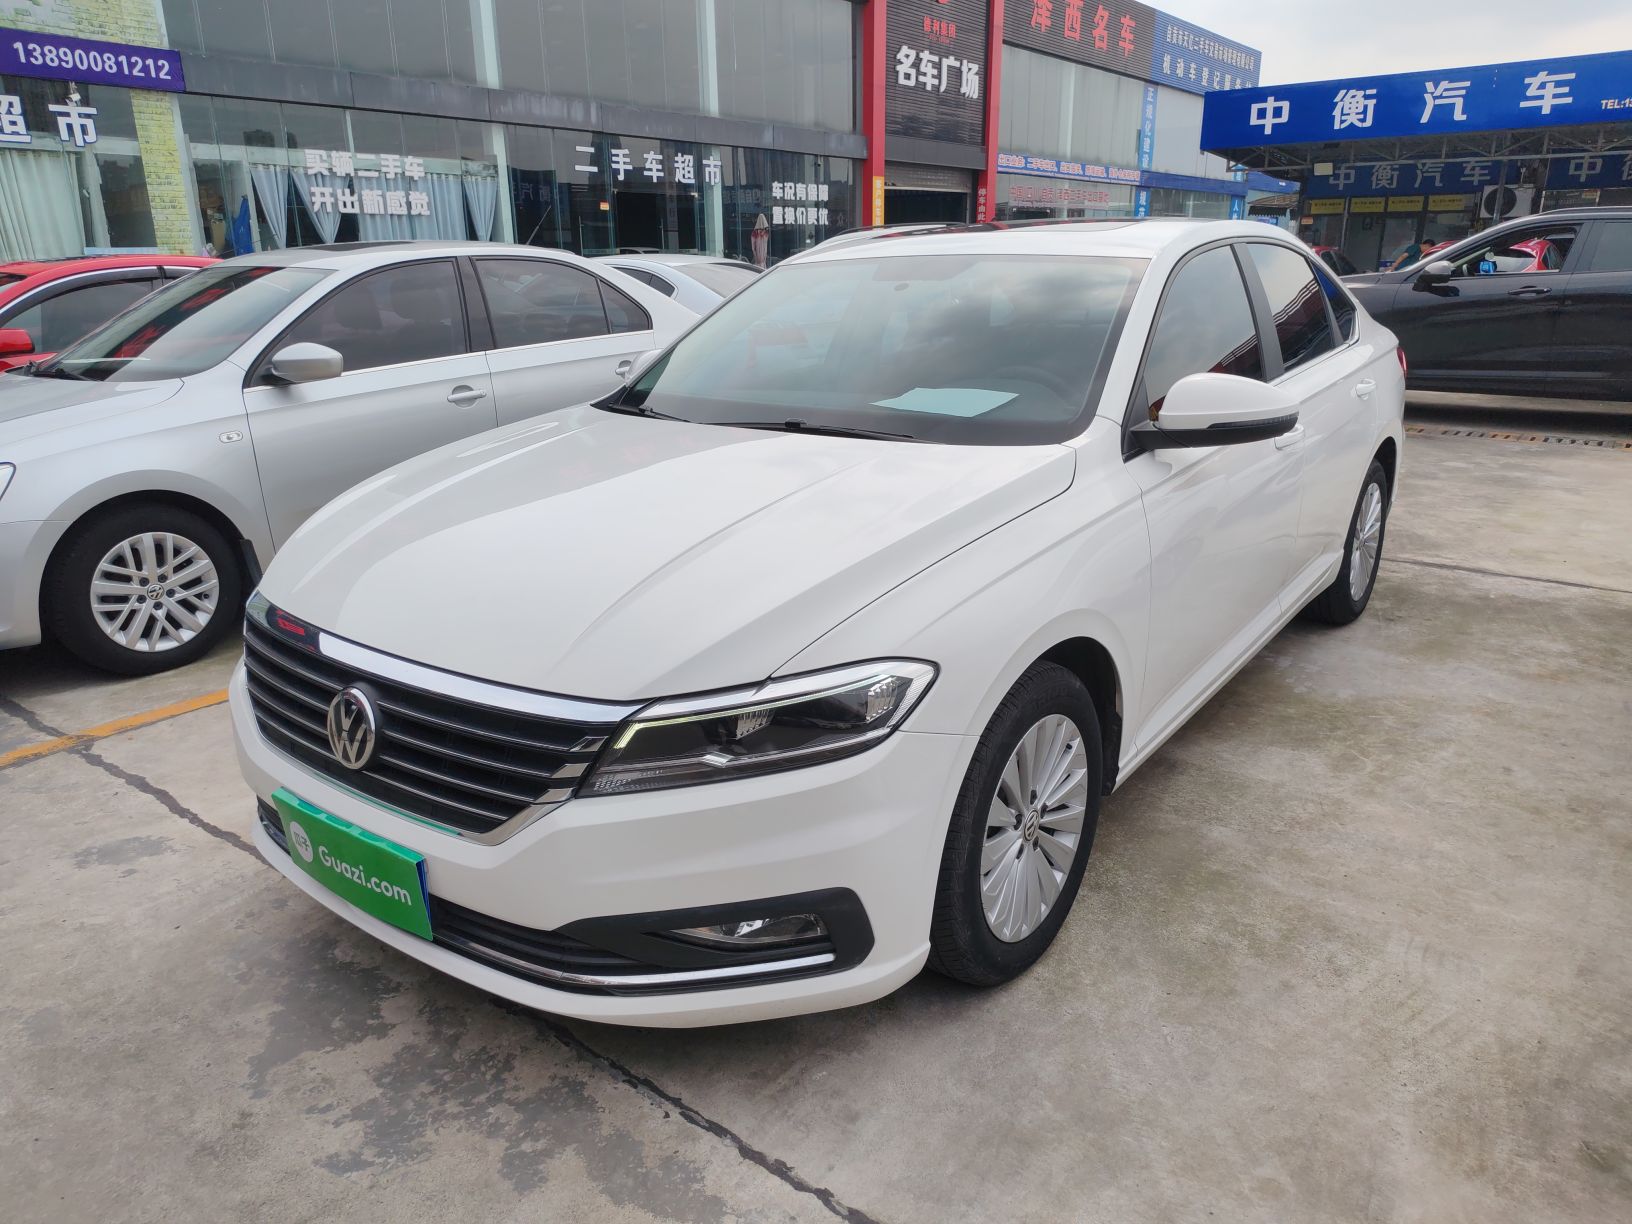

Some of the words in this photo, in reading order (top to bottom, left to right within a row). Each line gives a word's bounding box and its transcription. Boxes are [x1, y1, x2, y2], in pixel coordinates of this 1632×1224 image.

[13, 41, 171, 80] 13890081212
[895, 45, 979, 99] 名车广场
[1249, 71, 1576, 136] 中衡汽车
[304, 149, 426, 180] 买辆二手车
[574, 145, 722, 187] 二手车超市
[1328, 160, 1494, 191] 中衡汽车
[310, 186, 431, 216] 开出新感觉
[771, 181, 829, 202] 车况有保障
[771, 206, 829, 225] 置换价更优
[318, 845, 412, 906] Guazi.com
